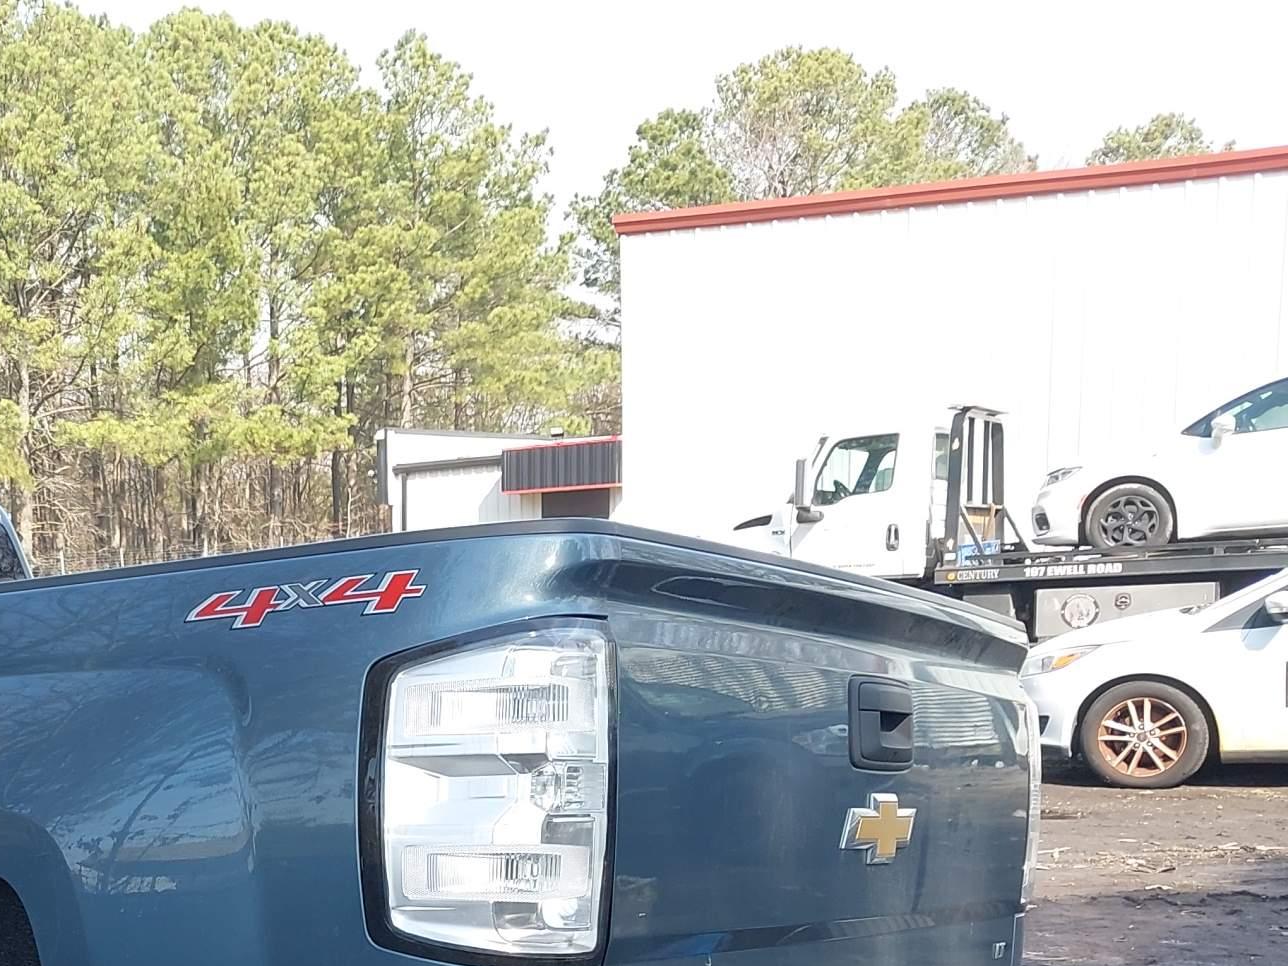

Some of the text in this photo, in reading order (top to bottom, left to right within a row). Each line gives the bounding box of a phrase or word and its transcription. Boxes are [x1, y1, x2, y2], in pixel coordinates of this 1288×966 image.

[957, 569, 1000, 581] CENTURY
[1047, 564, 1085, 576] EWELL
[1086, 563, 1122, 574] ROAD
